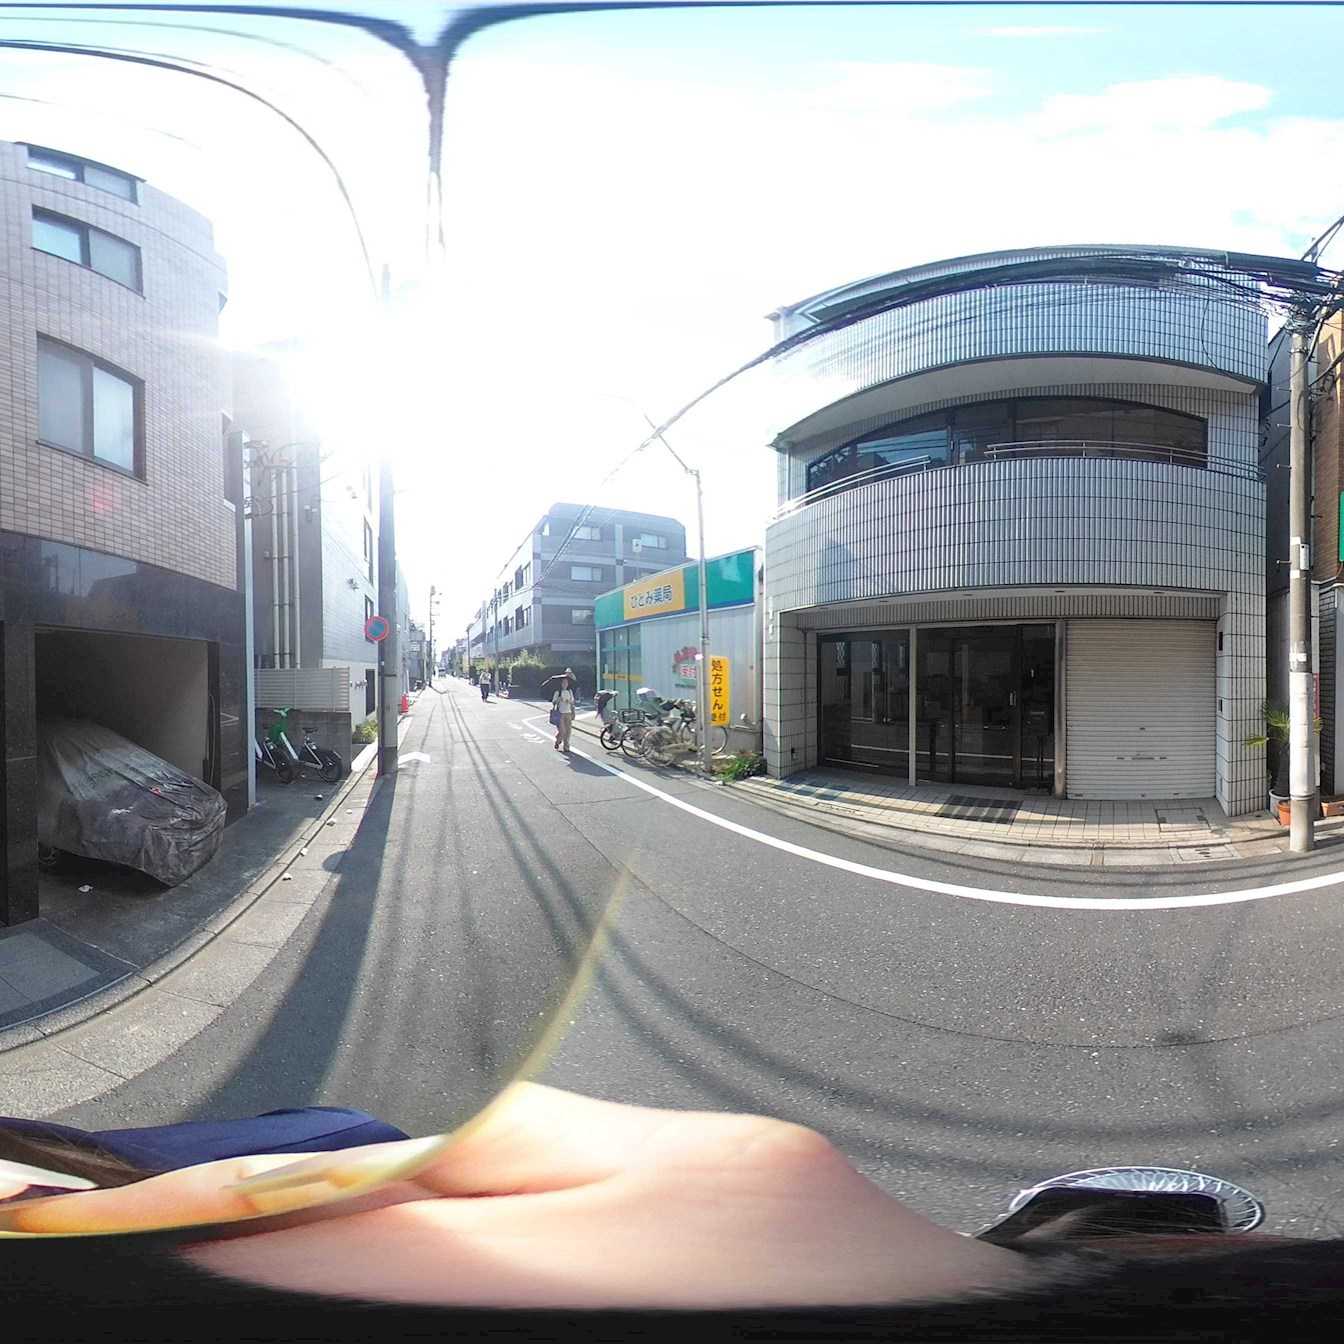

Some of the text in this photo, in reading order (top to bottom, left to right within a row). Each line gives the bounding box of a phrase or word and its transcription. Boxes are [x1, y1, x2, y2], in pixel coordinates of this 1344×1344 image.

[631, 584, 673, 609] ひとみ薬局
